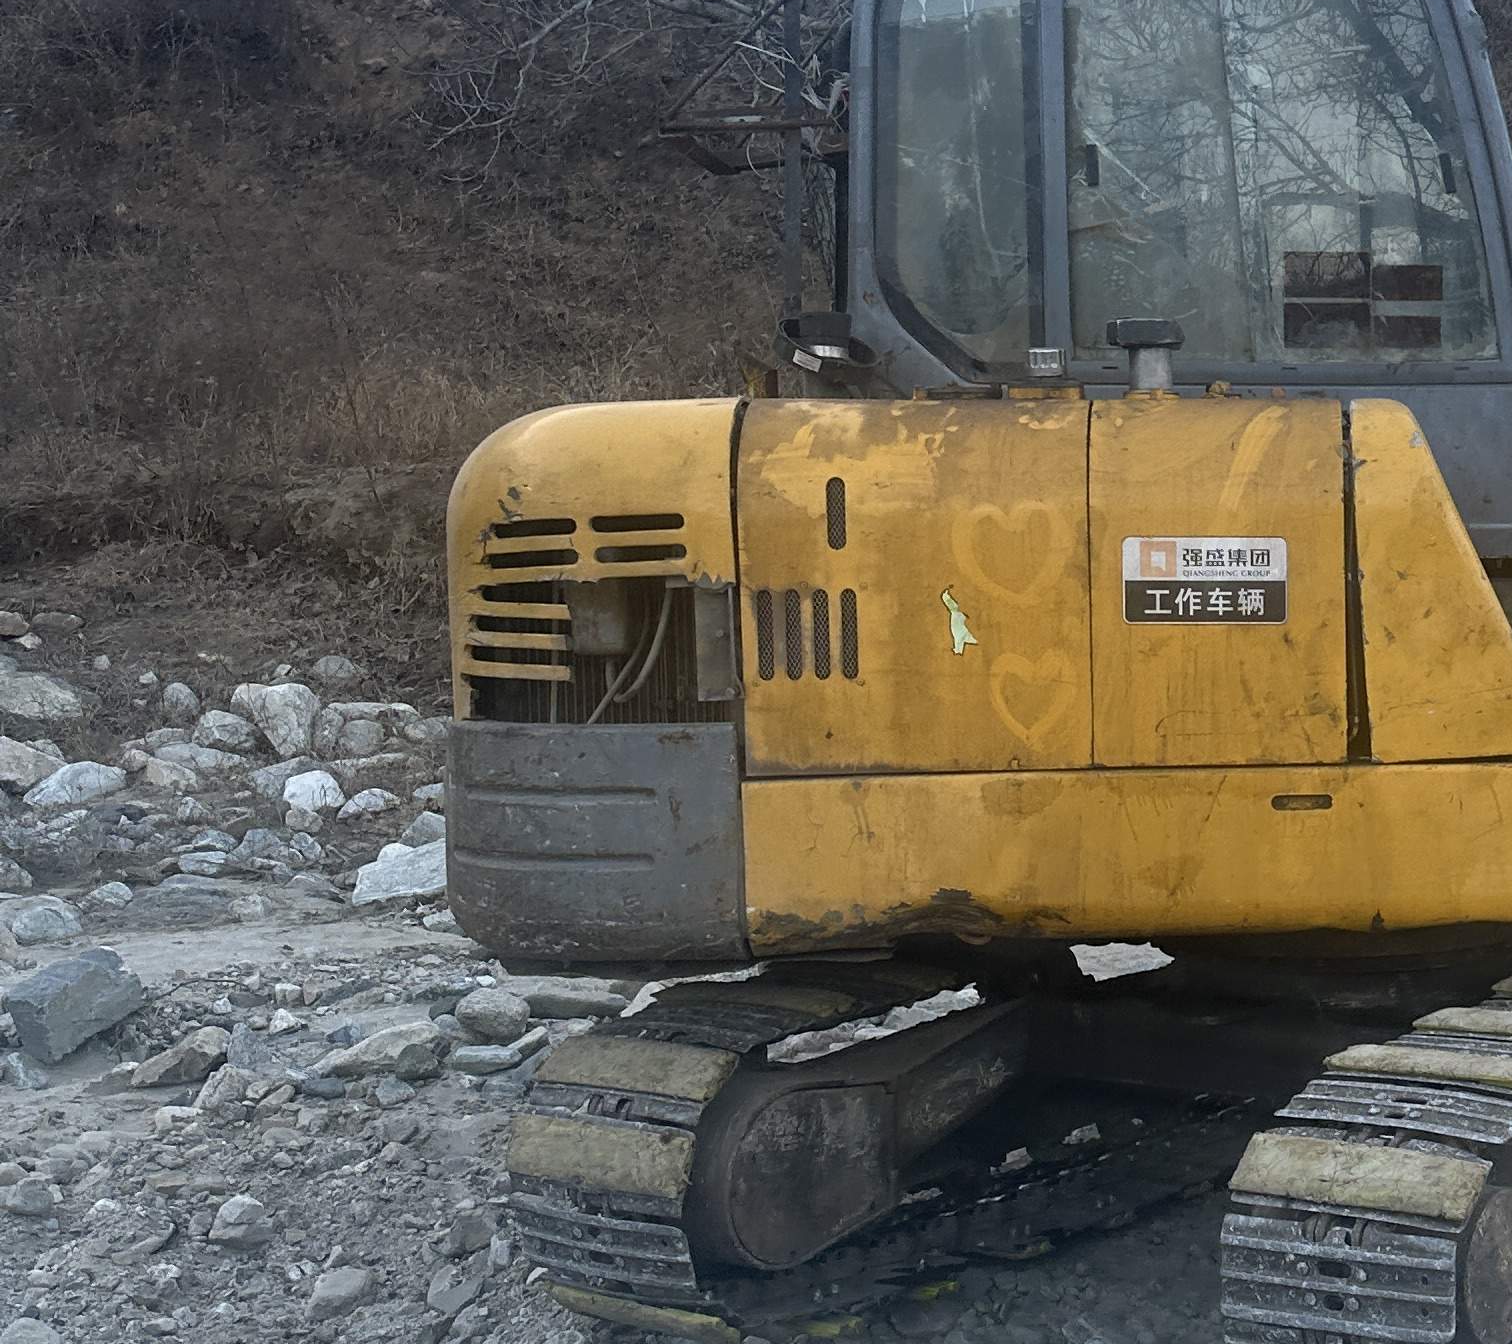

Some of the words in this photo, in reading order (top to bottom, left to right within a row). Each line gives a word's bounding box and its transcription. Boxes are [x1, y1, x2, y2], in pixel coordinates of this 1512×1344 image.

[1182, 548, 1271, 567] 强盛集团
[1240, 569, 1271, 577] GROUP
[1143, 587, 1266, 617] 工作车辆
